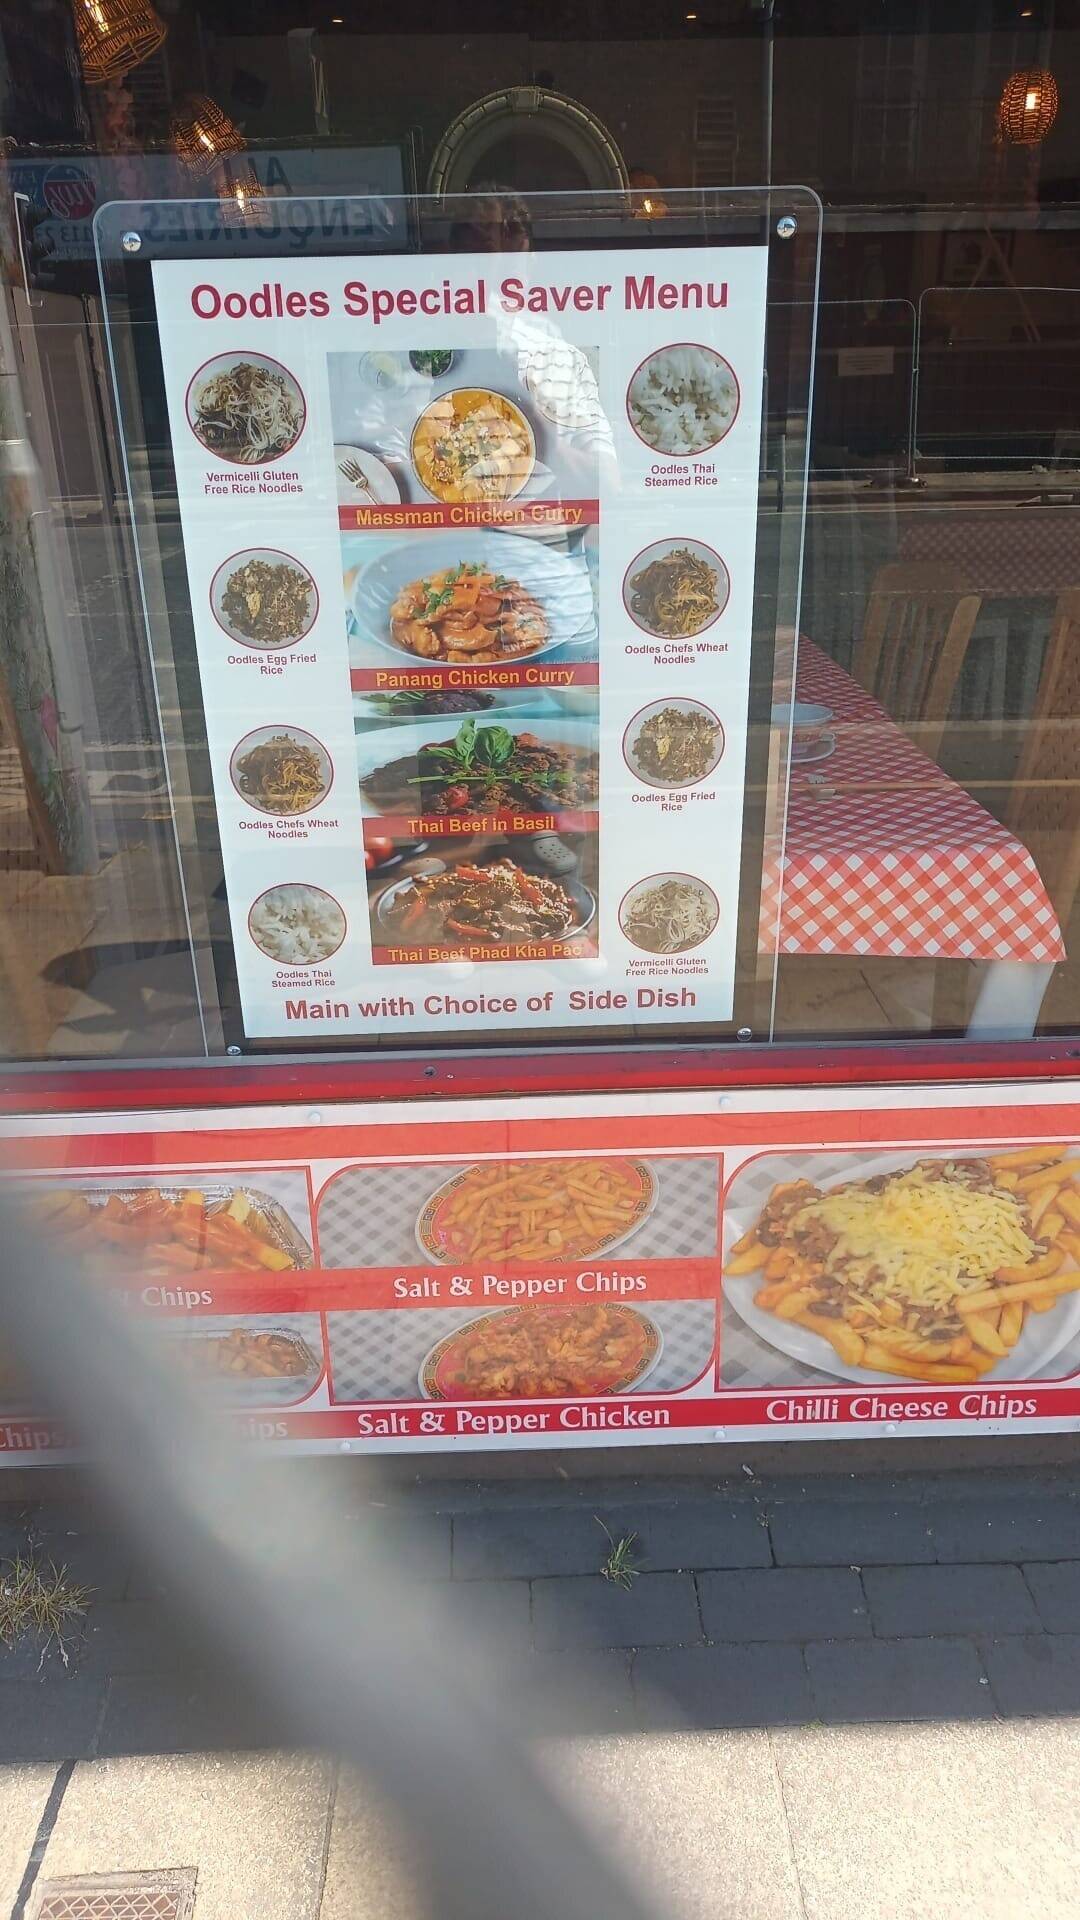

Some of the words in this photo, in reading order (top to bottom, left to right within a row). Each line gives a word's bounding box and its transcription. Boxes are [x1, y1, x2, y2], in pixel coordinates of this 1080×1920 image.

[191, 283, 330, 319] Oodles
[344, 280, 487, 325] Special
[500, 278, 612, 313] Saver
[625, 275, 728, 310] Menu
[651, 464, 689, 475] Oodles
[692, 463, 715, 474] Thai
[206, 471, 260, 482] Vermicelli
[262, 470, 299, 481] Gluten
[644, 476, 691, 487] Steamed
[694, 476, 718, 486] Rice
[204, 484, 229, 495] Free
[231, 484, 256, 494] Rice
[258, 483, 303, 493] Noodles
[356, 508, 444, 526] Massman
[450, 506, 525, 524] Chicken
[531, 506, 583, 524] Curry
[624, 645, 661, 655] Oodles
[663, 643, 694, 653] Chefs
[696, 643, 728, 652] Wheat
[227, 655, 264, 665] Oodles
[267, 654, 287, 666] Egg
[290, 653, 317, 663] Fried
[653, 655, 696, 665] Noodles
[260, 665, 283, 675] Rice
[375, 671, 443, 688] Panang
[449, 669, 520, 686] Chicken
[525, 667, 575, 685] Curry
[631, 793, 666, 803] Oodles
[668, 792, 688, 803] Egg
[690, 791, 716, 801] Fried
[661, 803, 683, 812] Rice
[238, 821, 274, 830] Oodles
[276, 820, 305, 829] Chefs
[307, 819, 339, 828] Wheat
[408, 819, 444, 833] Thai
[449, 817, 488, 832] Beef
[492, 817, 507, 831] in
[513, 816, 554, 831] Basil
[268, 830, 309, 839] Noodles
[388, 949, 423, 962] Thai
[428, 948, 465, 961] Beef
[469, 946, 510, 960] Phad
[515, 945, 547, 958] Kha
[628, 958, 674, 968] Vermicelli
[675, 958, 707, 966] Gluten
[276, 970, 309, 979] Oodles
[311, 970, 332, 978] Thai
[625, 968, 646, 977] Free
[648, 968, 669, 976] Rice
[671, 967, 709, 975] Noodles
[271, 979, 312, 988] Steamed
[314, 979, 336, 987] Rice
[285, 999, 350, 1020] Main
[358, 997, 415, 1017] with
[424, 994, 518, 1015] Choice
[526, 991, 554, 1012] of
[569, 990, 628, 1011] Side
[637, 987, 696, 1008] Dish
[393, 1277, 441, 1298] Salt
[450, 1276, 474, 1296] &
[483, 1275, 568, 1298] Pepper
[576, 1271, 647, 1295] Chips
[143, 1286, 213, 1309] Chips
[766, 1398, 839, 1421] Chilli
[850, 1396, 949, 1419] Cheese
[959, 1394, 1038, 1420] Chips
[357, 1412, 409, 1435] Salt
[419, 1410, 446, 1433] &
[456, 1409, 550, 1435] Pepper
[559, 1404, 671, 1428] Chicken
